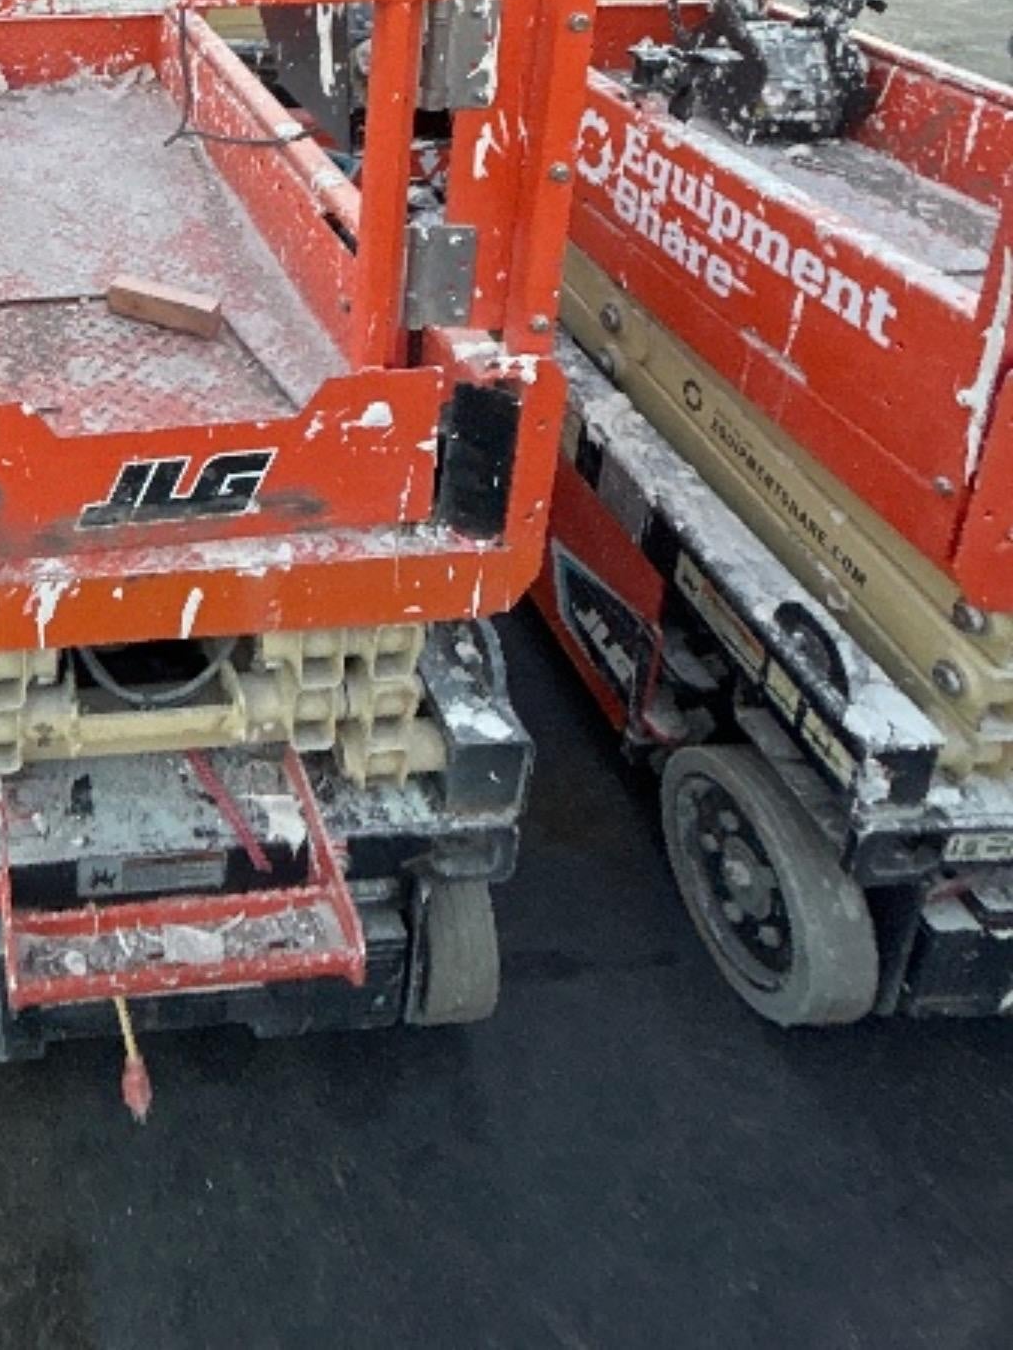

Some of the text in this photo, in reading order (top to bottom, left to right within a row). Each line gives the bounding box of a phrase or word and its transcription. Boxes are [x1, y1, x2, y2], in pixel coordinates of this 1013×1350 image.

[612, 175, 736, 298] Share
[618, 121, 897, 349] Equipment
[74, 446, 280, 532] JLG
